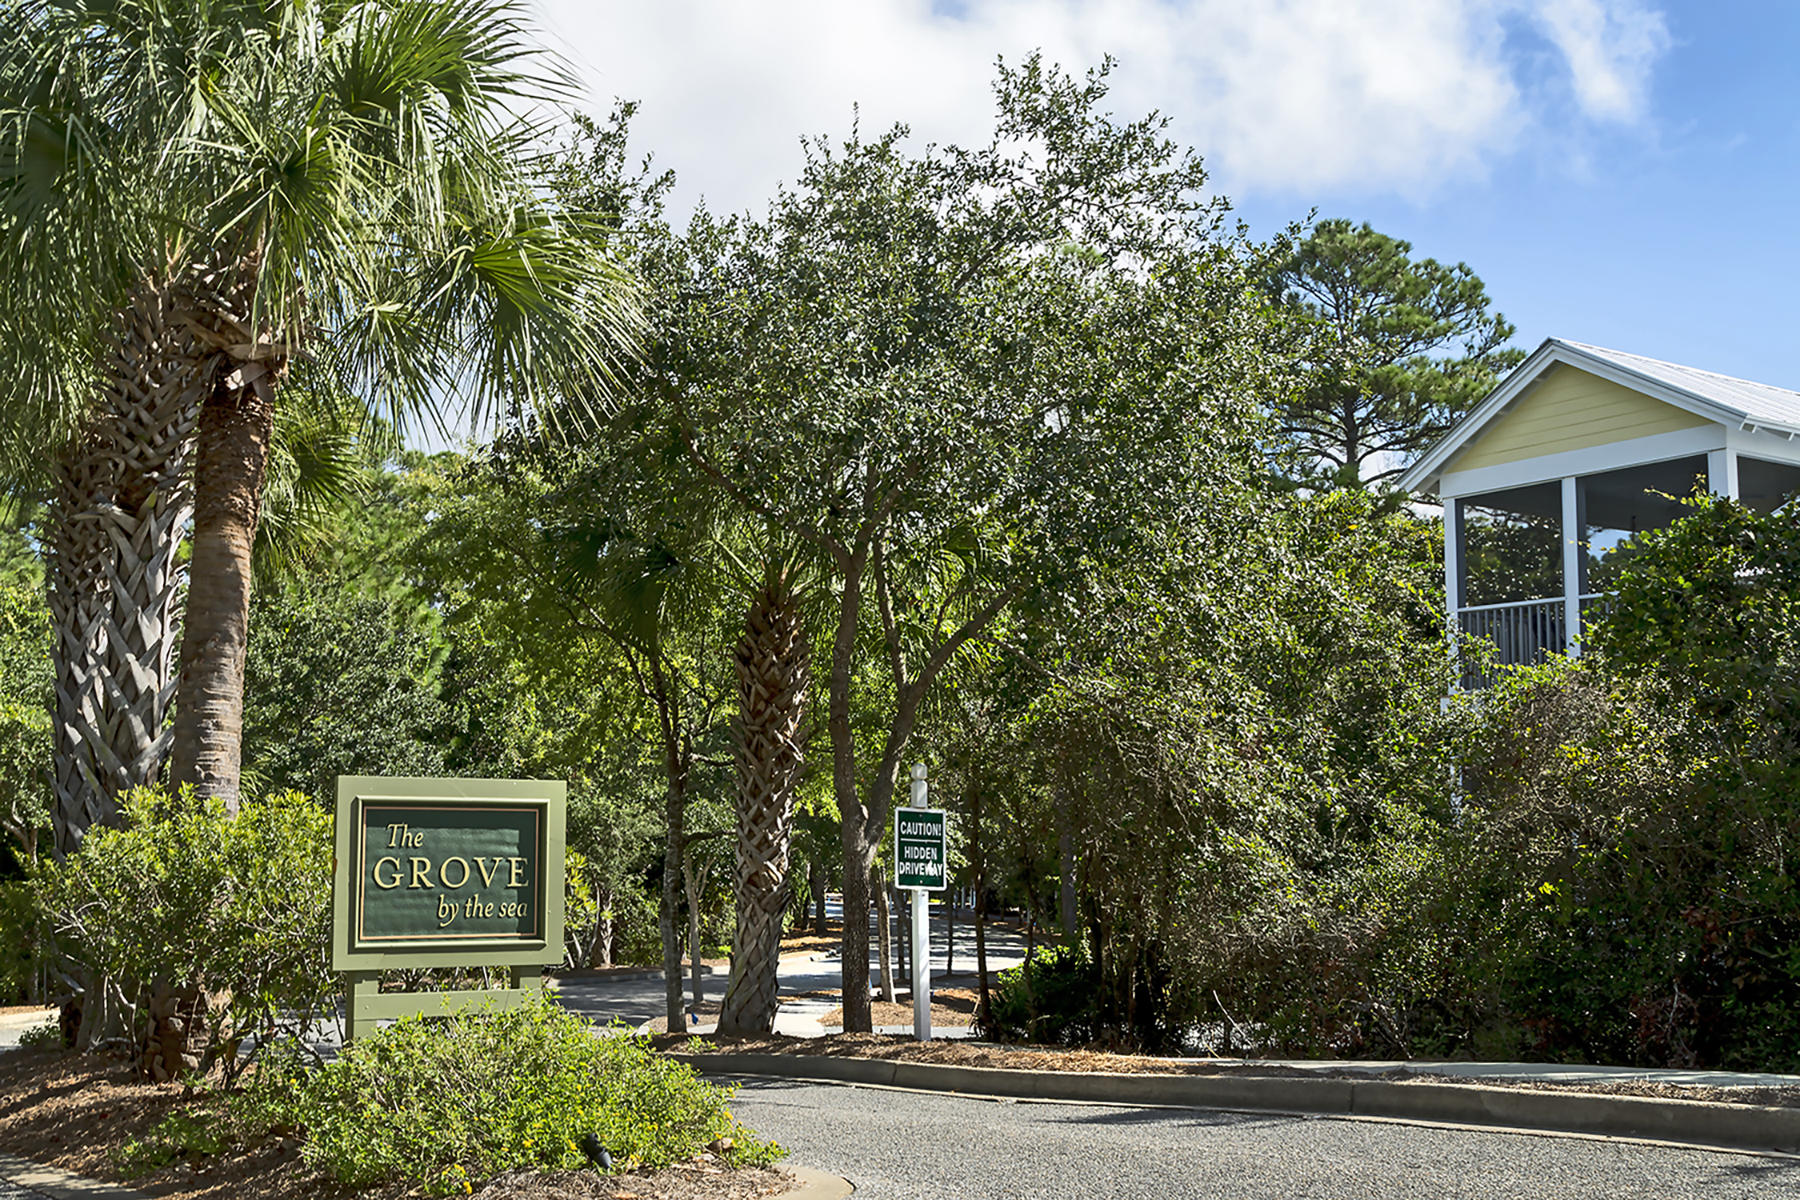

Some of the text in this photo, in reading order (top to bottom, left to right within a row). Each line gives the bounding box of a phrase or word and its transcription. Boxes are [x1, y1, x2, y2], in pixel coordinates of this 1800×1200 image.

[387, 822, 424, 847] The
[900, 821, 942, 836] CAUTION!
[904, 846, 937, 860] HIDDEN
[373, 856, 529, 889] GROVE
[438, 894, 528, 927] by the sea
